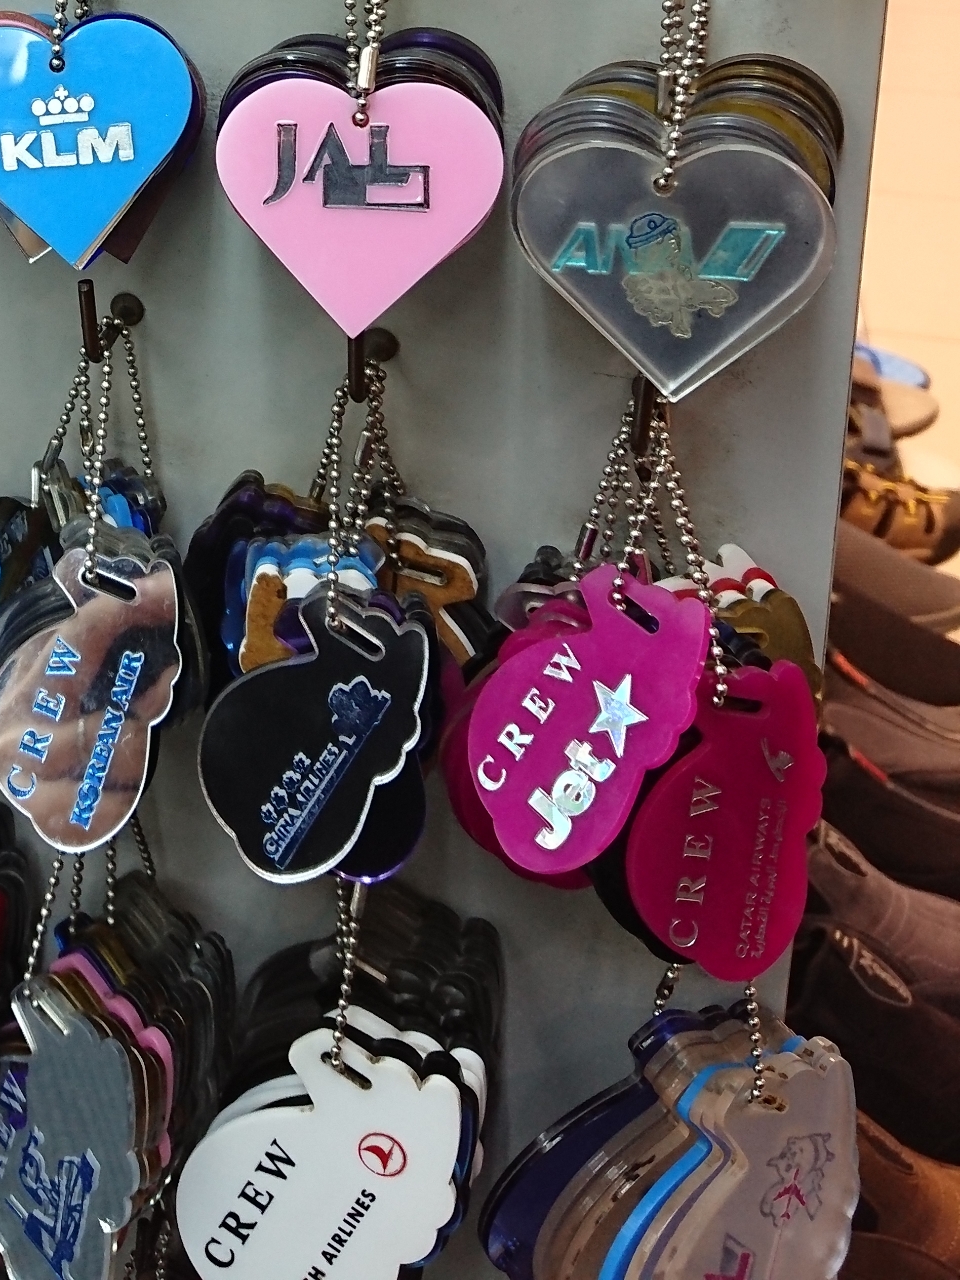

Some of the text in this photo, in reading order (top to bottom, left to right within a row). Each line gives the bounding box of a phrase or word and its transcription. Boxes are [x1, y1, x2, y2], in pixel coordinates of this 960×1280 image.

[0, 121, 135, 172] KLM
[262, 120, 431, 213] JAL
[6, 634, 82, 800] CREW
[69, 650, 145, 831] KOREAN AIR
[476, 642, 582, 792] CREW
[262, 805, 303, 860] CHINA
[295, 742, 341, 812] AIRLINES
[526, 738, 617, 851] Jet
[668, 775, 722, 948] CREW
[735, 797, 772, 959] QATAR AIRWAYS
[203, 1137, 297, 1269] CREW
[320, 1188, 377, 1267] AIRLINES
